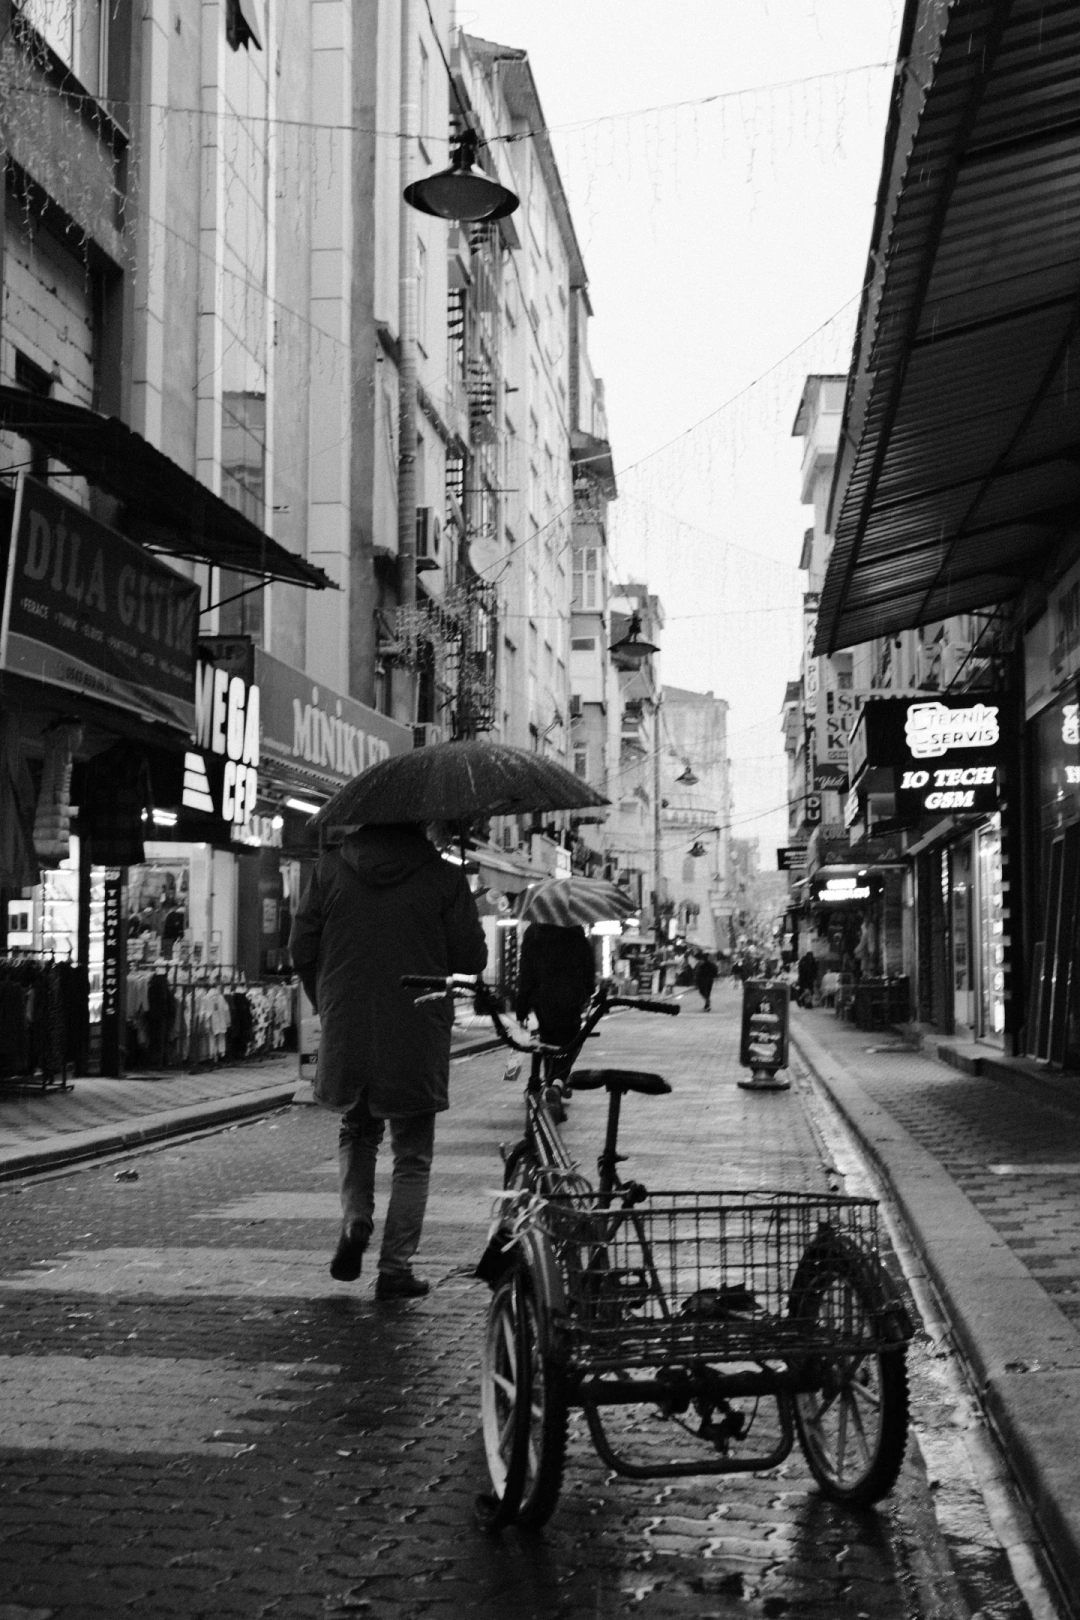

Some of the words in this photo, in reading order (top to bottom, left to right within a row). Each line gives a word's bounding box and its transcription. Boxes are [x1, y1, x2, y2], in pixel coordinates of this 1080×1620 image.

[195, 659, 261, 768] MEGA
[931, 727, 995, 745] SERVİS
[933, 766, 996, 787] TECH
[222, 760, 258, 826] CEP
[925, 791, 975, 810] GSM
